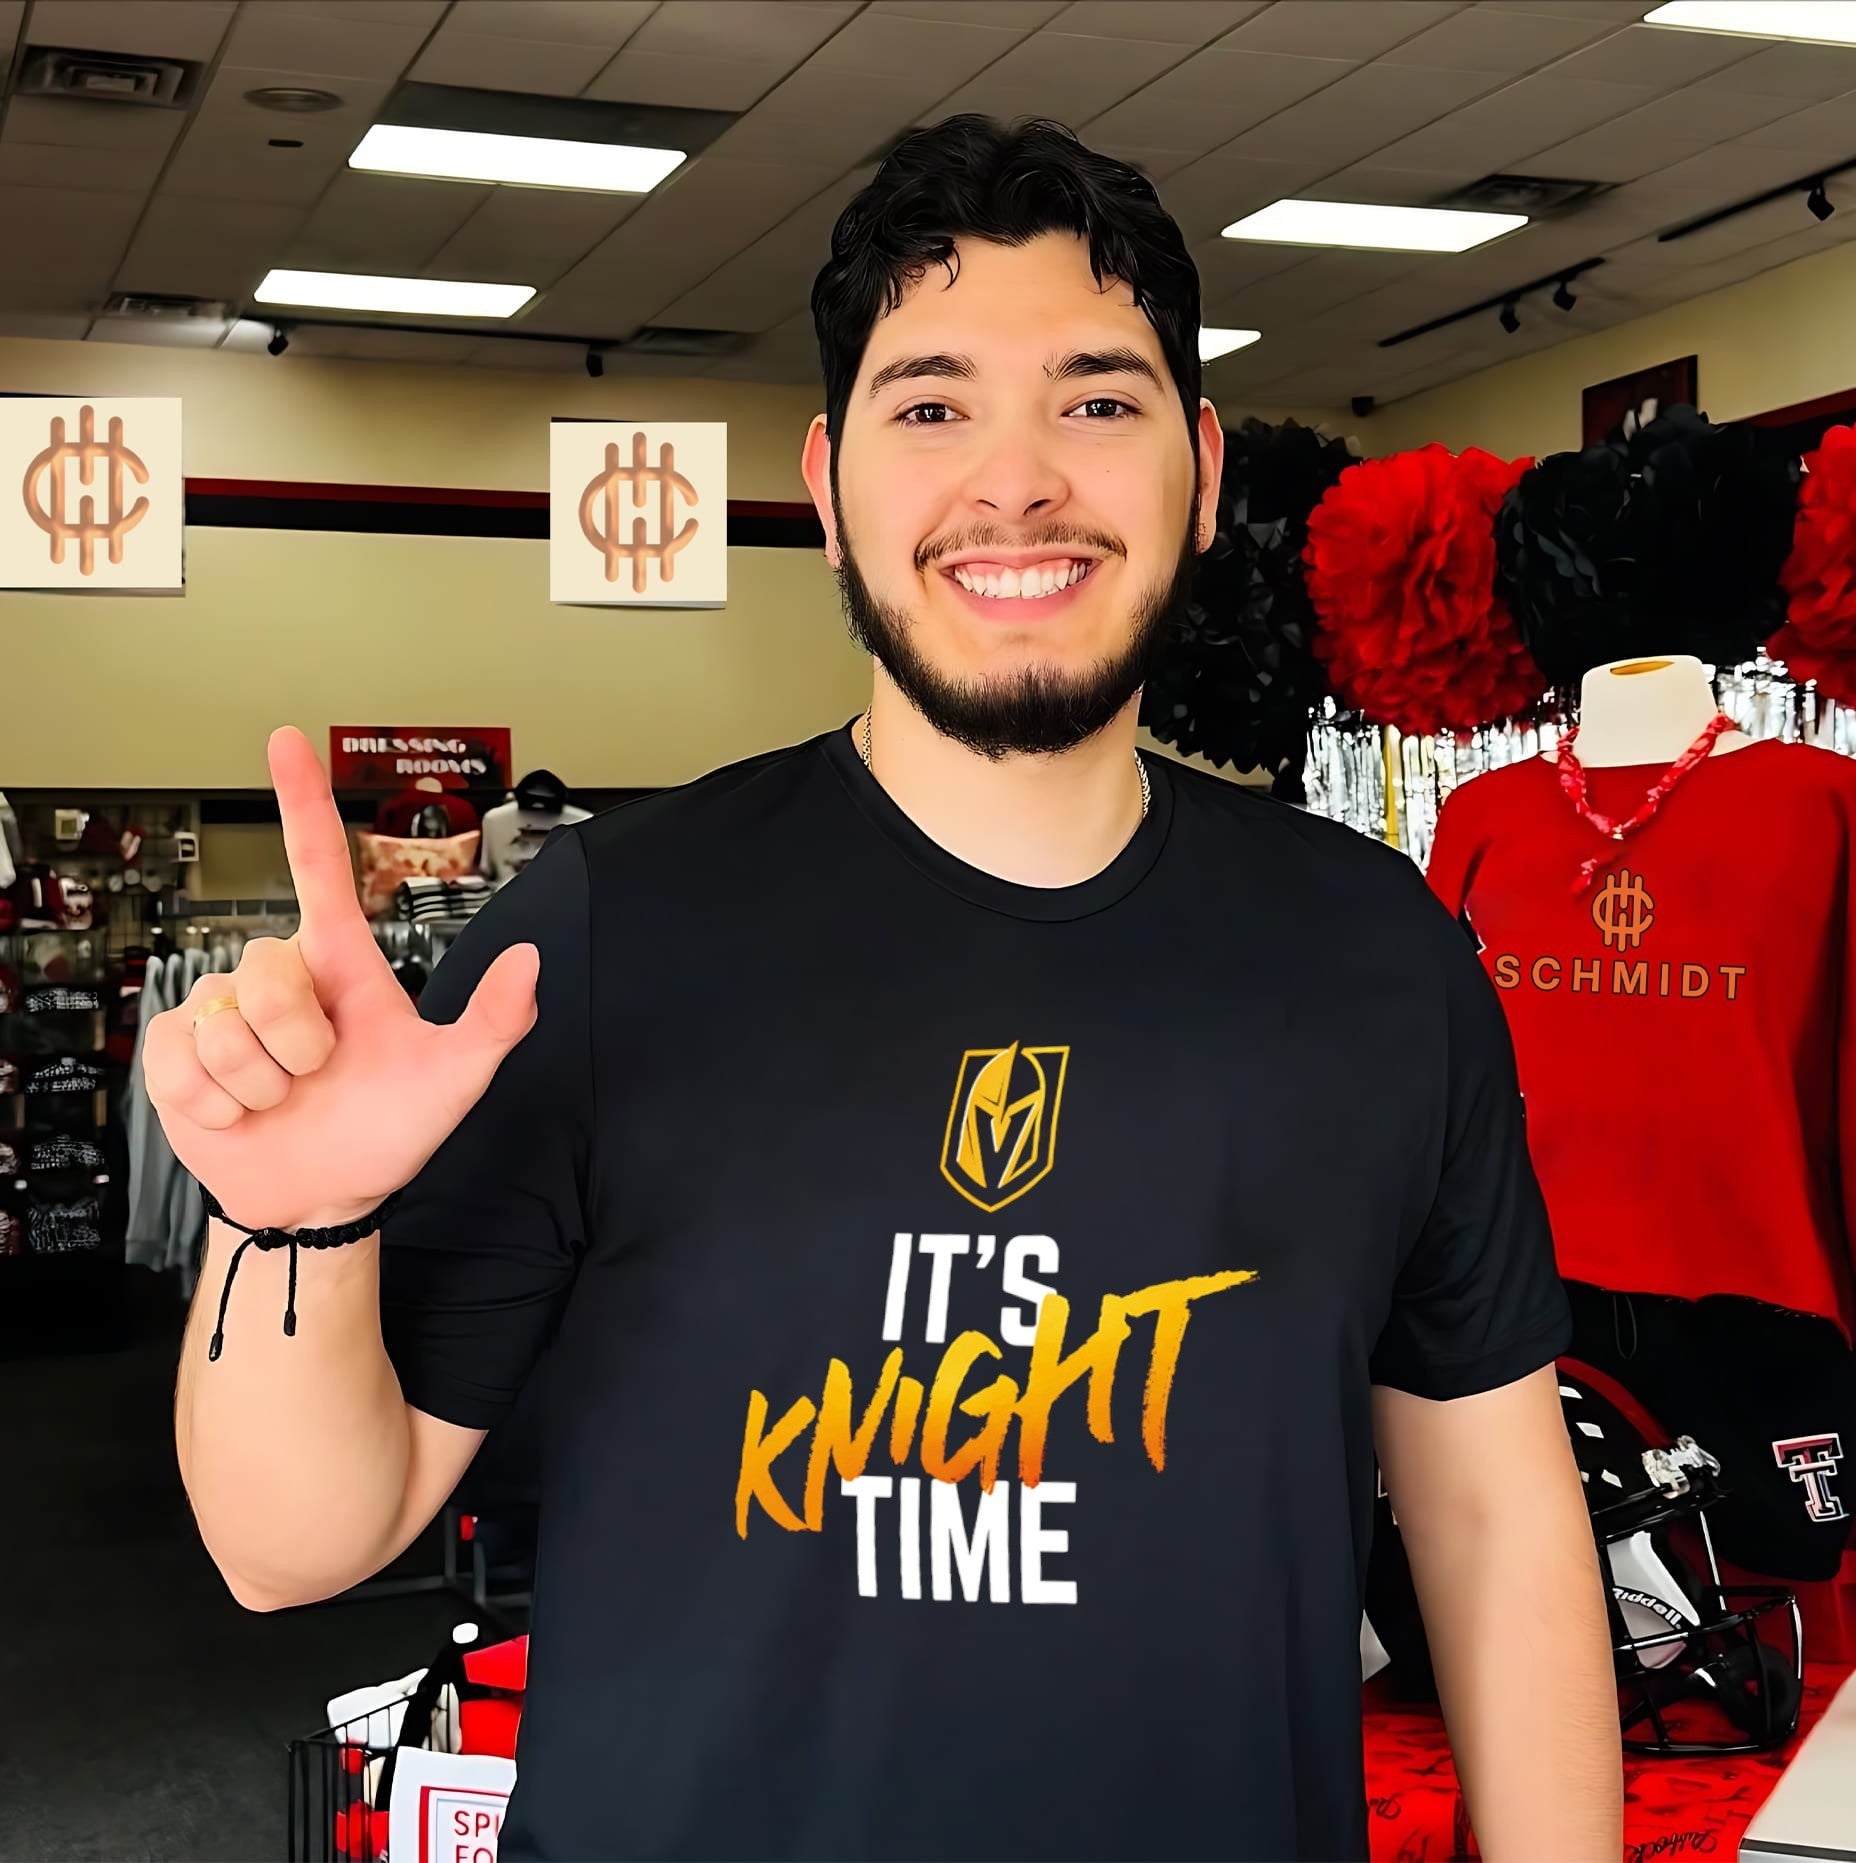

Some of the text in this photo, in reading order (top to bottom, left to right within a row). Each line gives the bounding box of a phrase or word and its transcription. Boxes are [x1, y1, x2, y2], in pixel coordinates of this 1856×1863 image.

[342, 737, 466, 754] DRESSING
[396, 758, 487, 775] ROOMS
[1494, 954, 1747, 1000] SCHMIDT
[882, 1232, 1060, 1347] IT'S
[735, 1269, 1259, 1541] KNIGHT
[841, 1475, 1078, 1605] TIME
